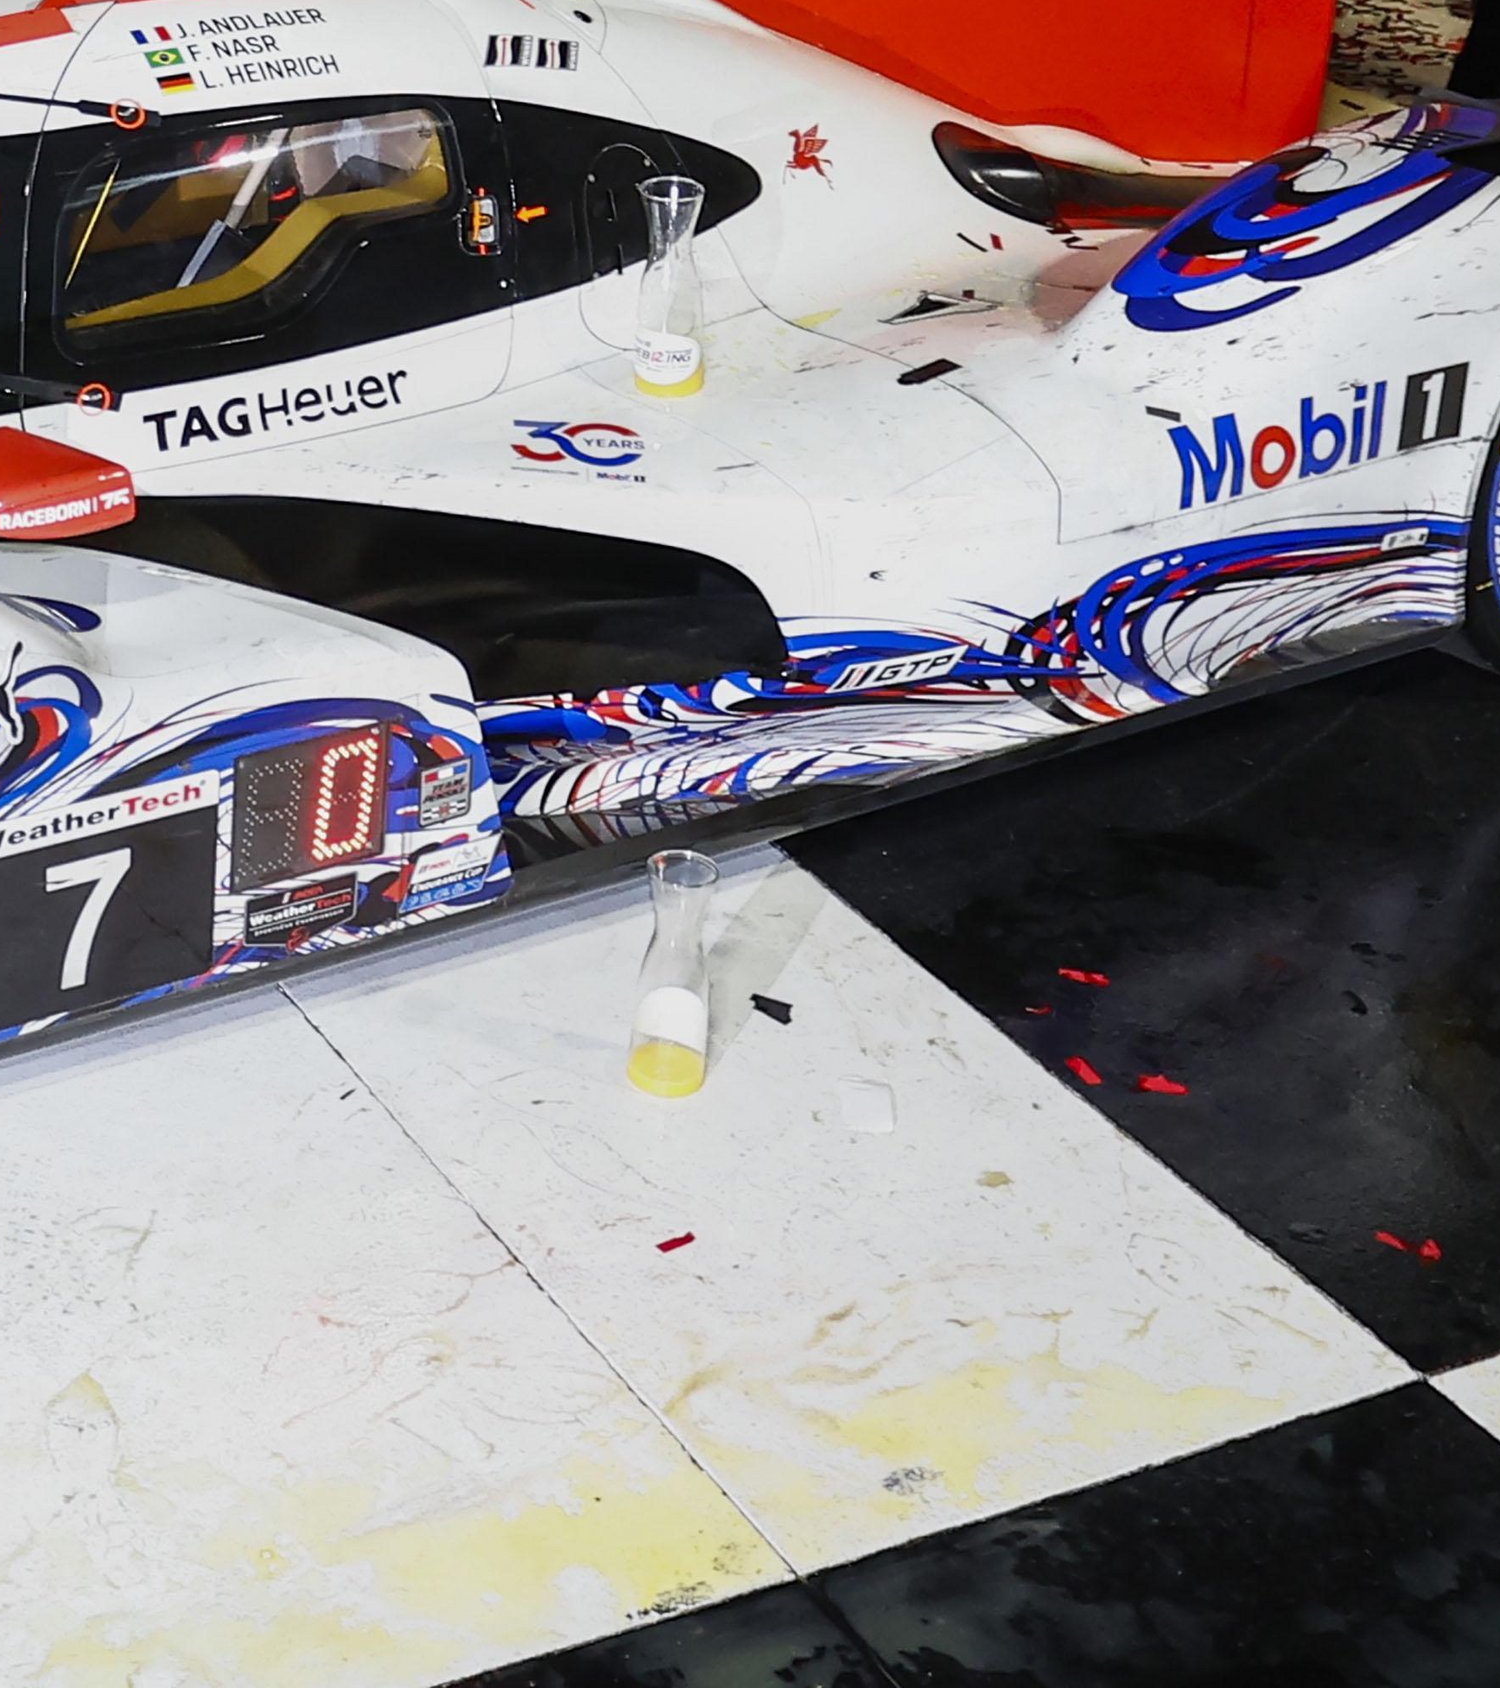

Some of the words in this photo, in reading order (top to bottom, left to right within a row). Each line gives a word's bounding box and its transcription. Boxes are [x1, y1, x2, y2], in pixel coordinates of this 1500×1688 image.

[176, 21, 194, 39] J.
[197, 7, 327, 37] ANDLAUER
[188, 45, 206, 63] F.
[211, 35, 279, 61] NASR
[202, 70, 224, 89] L.
[229, 53, 341, 86] HEINRICH
[583, 437, 645, 451] YEARS
[1168, 380, 1389, 511] Mobil
[1406, 367, 1462, 449] 1
[876, 654, 955, 685] GTP
[44, 847, 132, 994] 7
